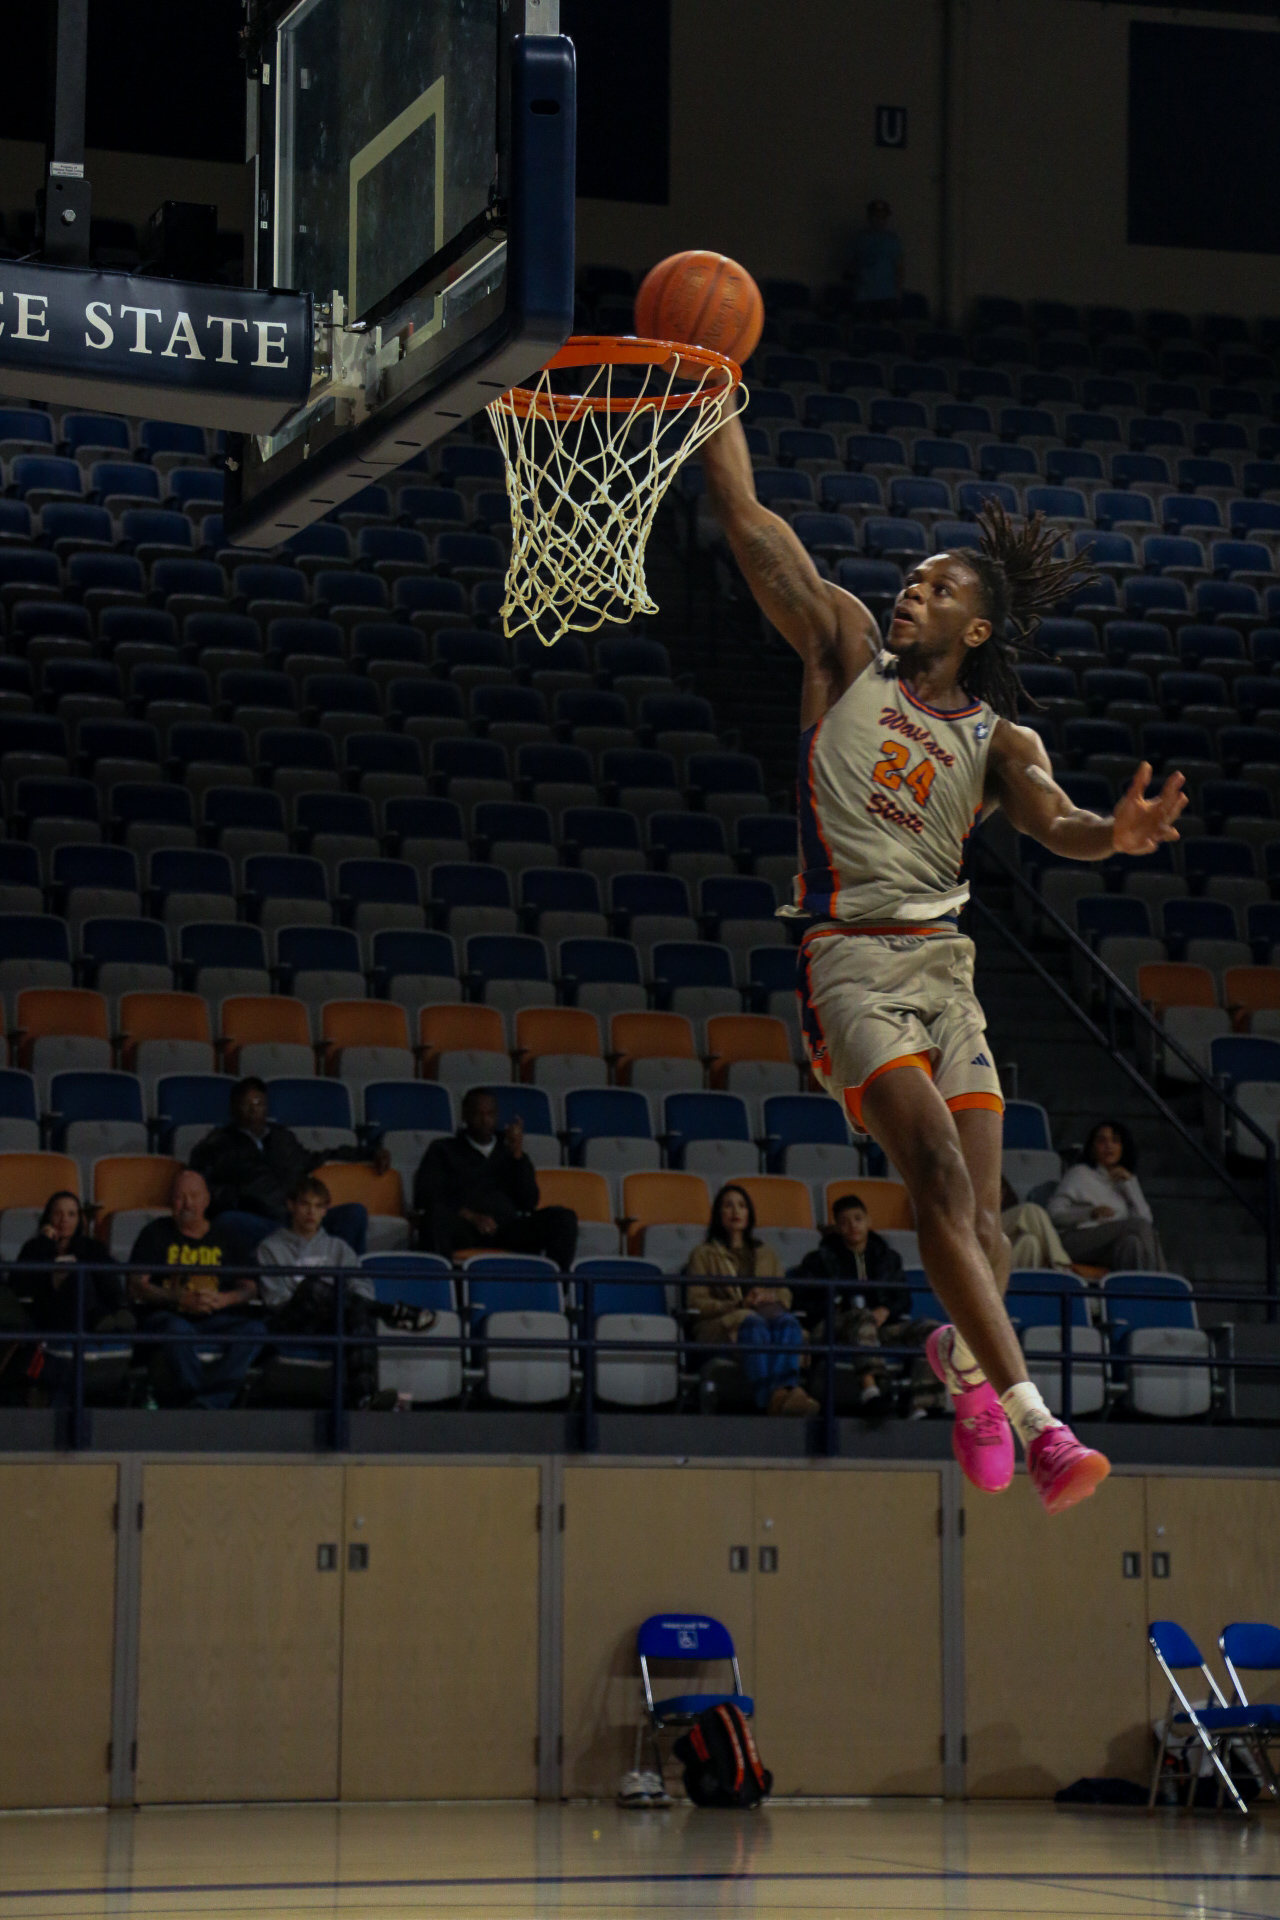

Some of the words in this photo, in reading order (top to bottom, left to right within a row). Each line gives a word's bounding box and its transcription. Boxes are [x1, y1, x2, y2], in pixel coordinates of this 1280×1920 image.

[881, 109, 904, 144] U
[85, 301, 289, 369] STATE
[872, 739, 937, 808] 24
[865, 791, 925, 835] State
